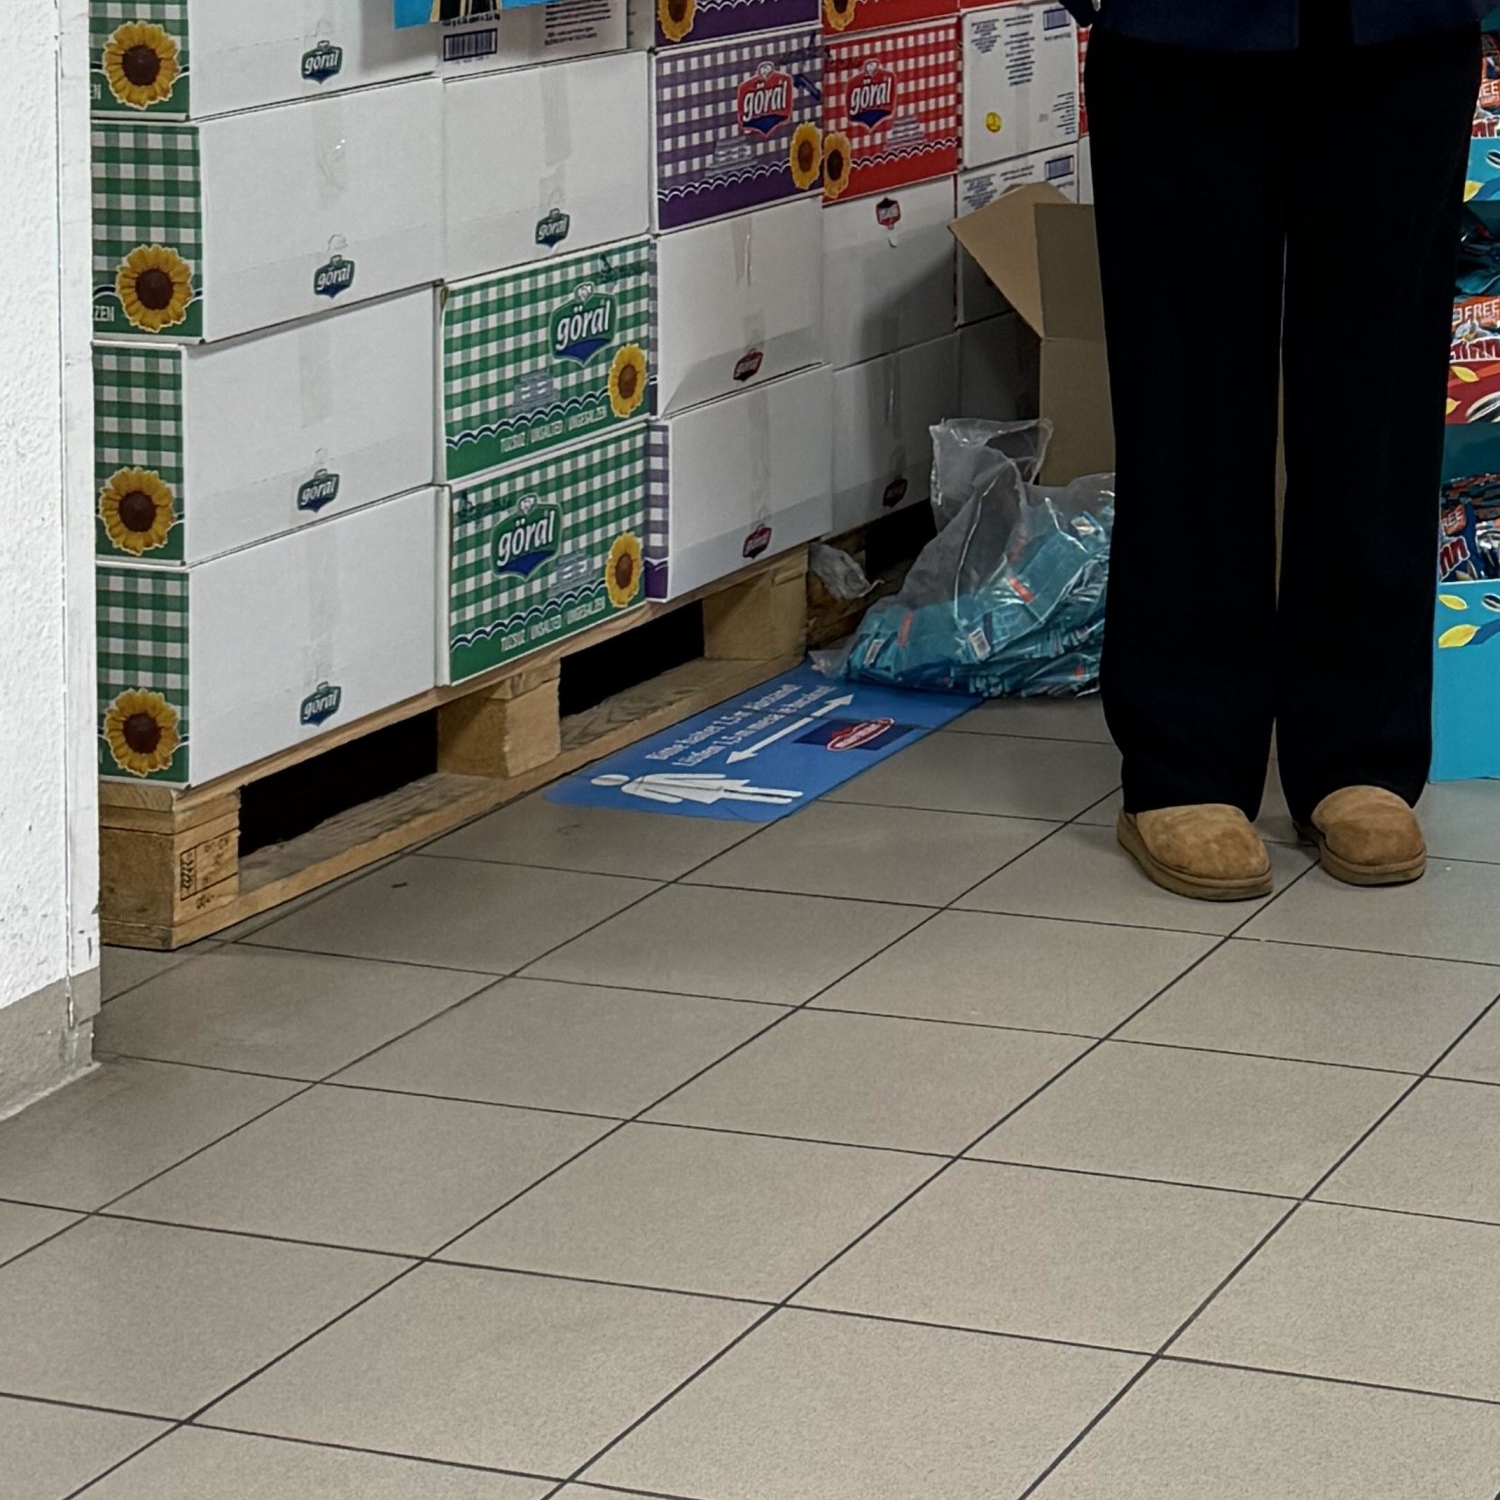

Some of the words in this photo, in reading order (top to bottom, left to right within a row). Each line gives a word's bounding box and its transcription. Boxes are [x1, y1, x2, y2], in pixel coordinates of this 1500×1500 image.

[743, 81, 788, 119] göral
[850, 77, 892, 113] göral
[556, 300, 611, 350] göral
[1464, 299, 1500, 320] FREE
[497, 510, 555, 566] göral
